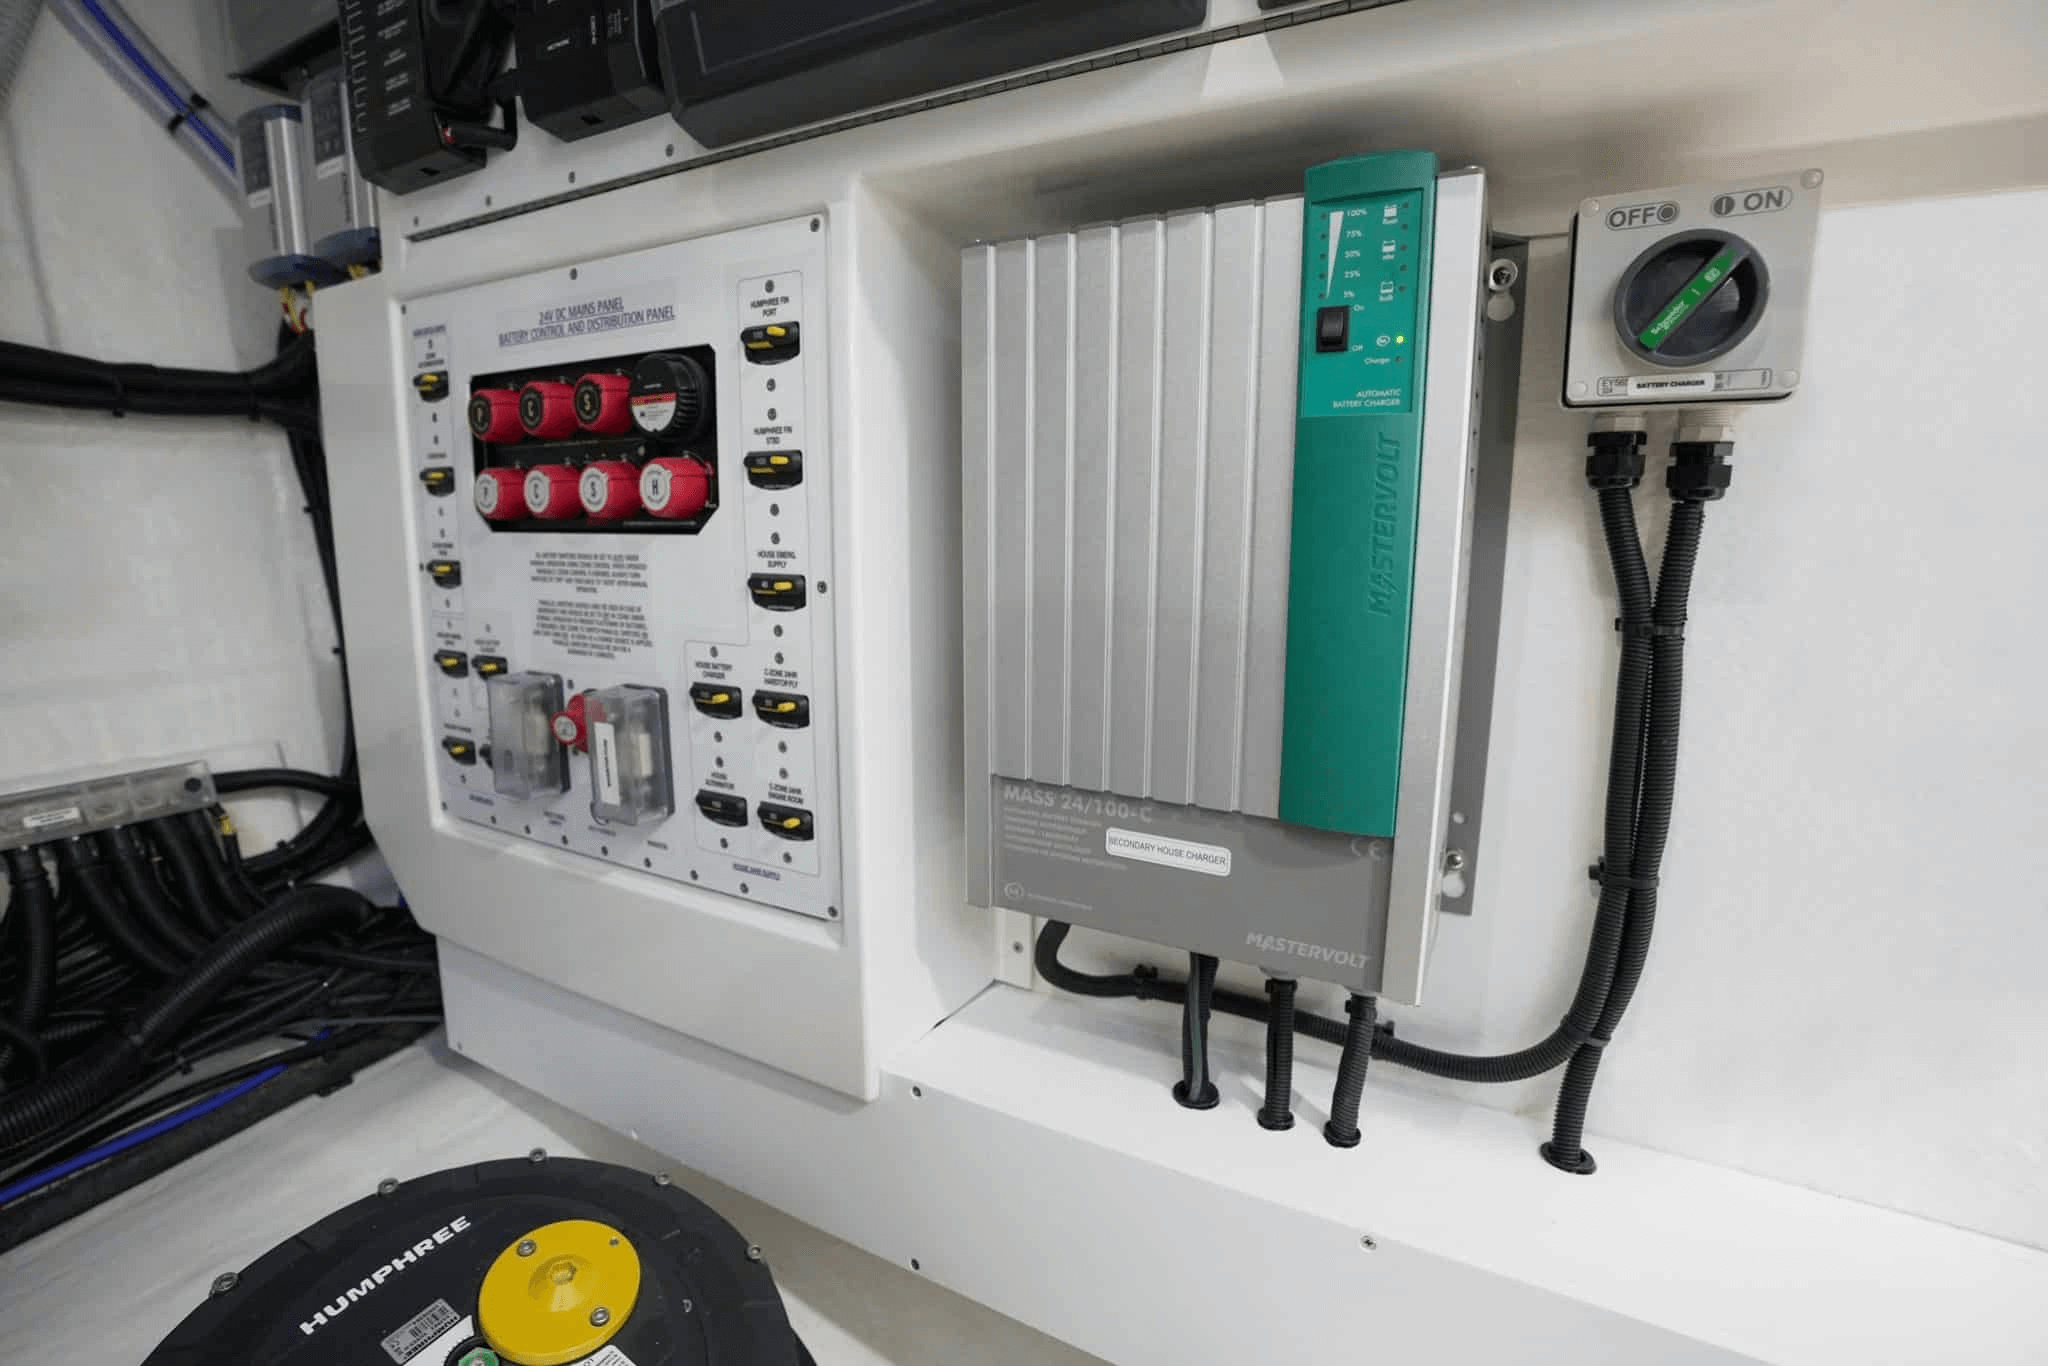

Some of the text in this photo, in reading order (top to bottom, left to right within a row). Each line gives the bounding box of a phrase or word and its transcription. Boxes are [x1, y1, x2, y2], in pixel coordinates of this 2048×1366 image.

[1743, 189, 1785, 211] ON
[1346, 208, 1368, 216] 100%
[1608, 208, 1657, 228] OFF
[1346, 229, 1362, 238] 75%
[1344, 250, 1361, 258] 50%
[1344, 270, 1361, 278] 25%
[539, 296, 625, 325] 24V DC MAINS PANEL
[498, 304, 676, 347] BATTERY CONTROL AND DISTRIBUTION PANEL
[1356, 388, 1401, 398] AUTOMATIC
[1636, 381, 1669, 390] BATTERY
[1670, 379, 1705, 388] CHARGER
[1332, 397, 1401, 409] BATTERY CHARGER
[651, 479, 659, 496] H
[1368, 431, 1401, 617] MASTERVOLT
[757, 550, 775, 559] HOUSE
[1003, 784, 1154, 822] MASS 24/100-C
[1110, 838, 1226, 865] SECONDARY HOUSE CHARGER
[1245, 931, 1373, 968] MASTERVOLT
[299, 1215, 472, 1336] HUMPHREE
